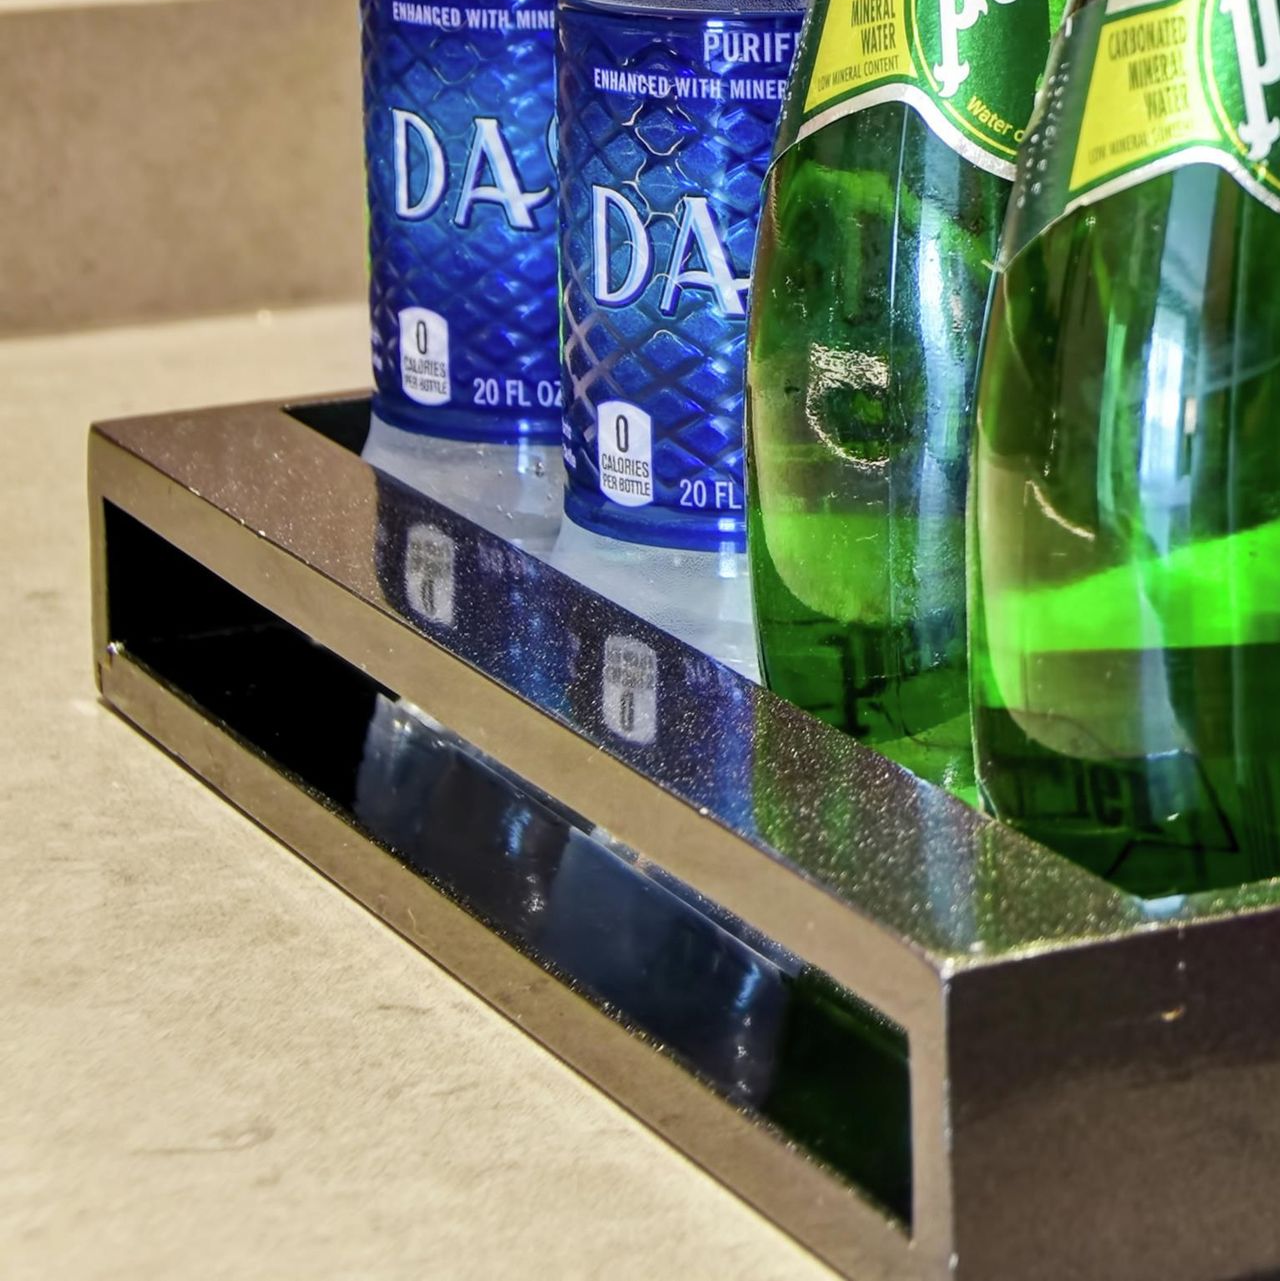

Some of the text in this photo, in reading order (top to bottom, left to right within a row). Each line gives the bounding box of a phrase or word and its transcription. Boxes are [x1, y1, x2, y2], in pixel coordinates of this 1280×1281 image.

[392, 0, 461, 28] ENHANCED
[465, 7, 513, 30] WITH
[860, 21, 896, 56] WATER
[1108, 16, 1187, 61] CARBONATED
[594, 68, 671, 98] ENHANCED
[675, 76, 722, 99] WITH
[817, 54, 900, 93] LOW MINERAL CONTENT
[1128, 49, 1187, 91] MINERAL
[965, 95, 1013, 136] Water
[416, 319, 428, 355] 0
[473, 377, 500, 406] 20
[506, 379, 532, 407] FL
[616, 414, 629, 454] 0
[602, 453, 650, 479] CALORIES
[602, 473, 650, 497] PER BOTTLE
[679, 478, 743, 510] 20 FL
